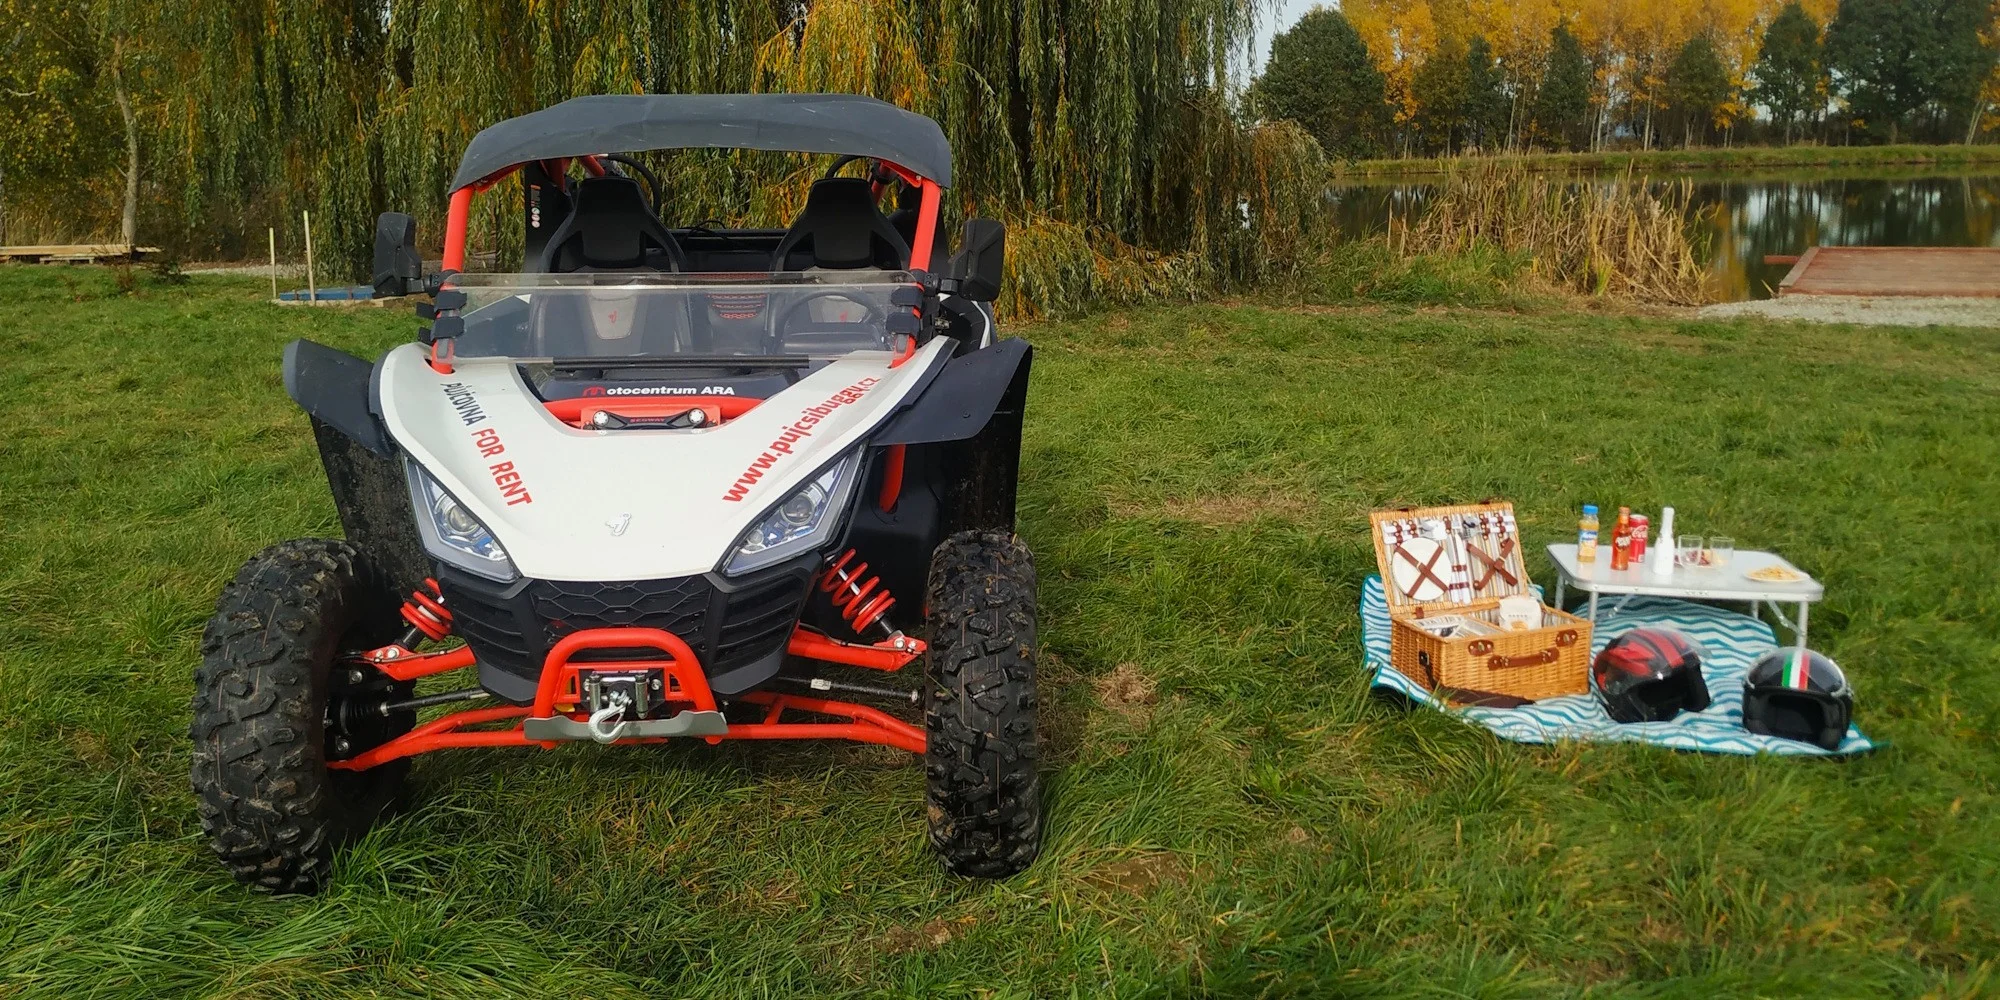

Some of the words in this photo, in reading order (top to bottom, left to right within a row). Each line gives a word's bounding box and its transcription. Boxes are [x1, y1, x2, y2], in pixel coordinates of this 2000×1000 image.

[701, 386, 735, 395] ARA
[471, 428, 505, 458] FOR
[489, 461, 533, 506] RENT
[722, 377, 880, 502] www.pujcsibuggy.cz
